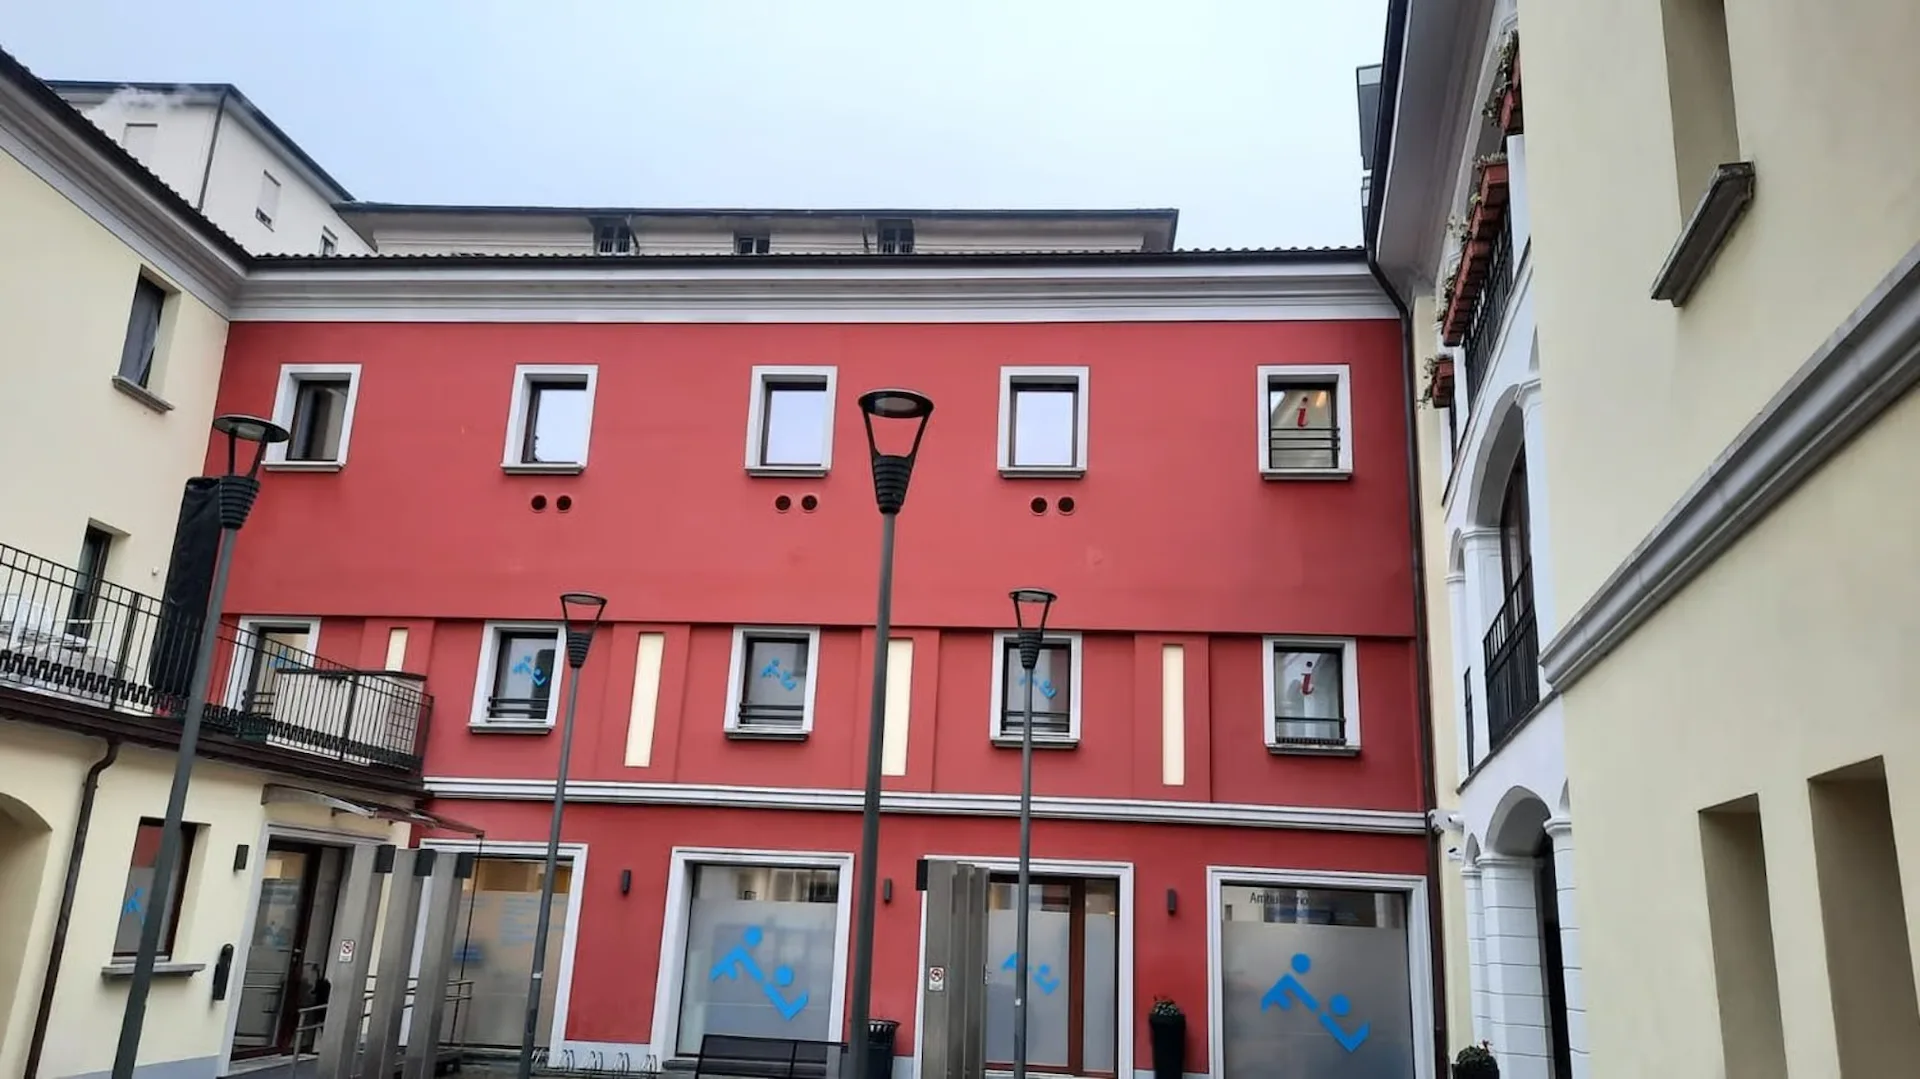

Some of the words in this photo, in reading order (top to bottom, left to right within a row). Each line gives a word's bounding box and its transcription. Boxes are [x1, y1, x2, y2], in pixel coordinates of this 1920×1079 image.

[1297, 397, 1309, 428] i
[1301, 661, 1315, 696] i
[1250, 891, 1309, 905] Ambuio
